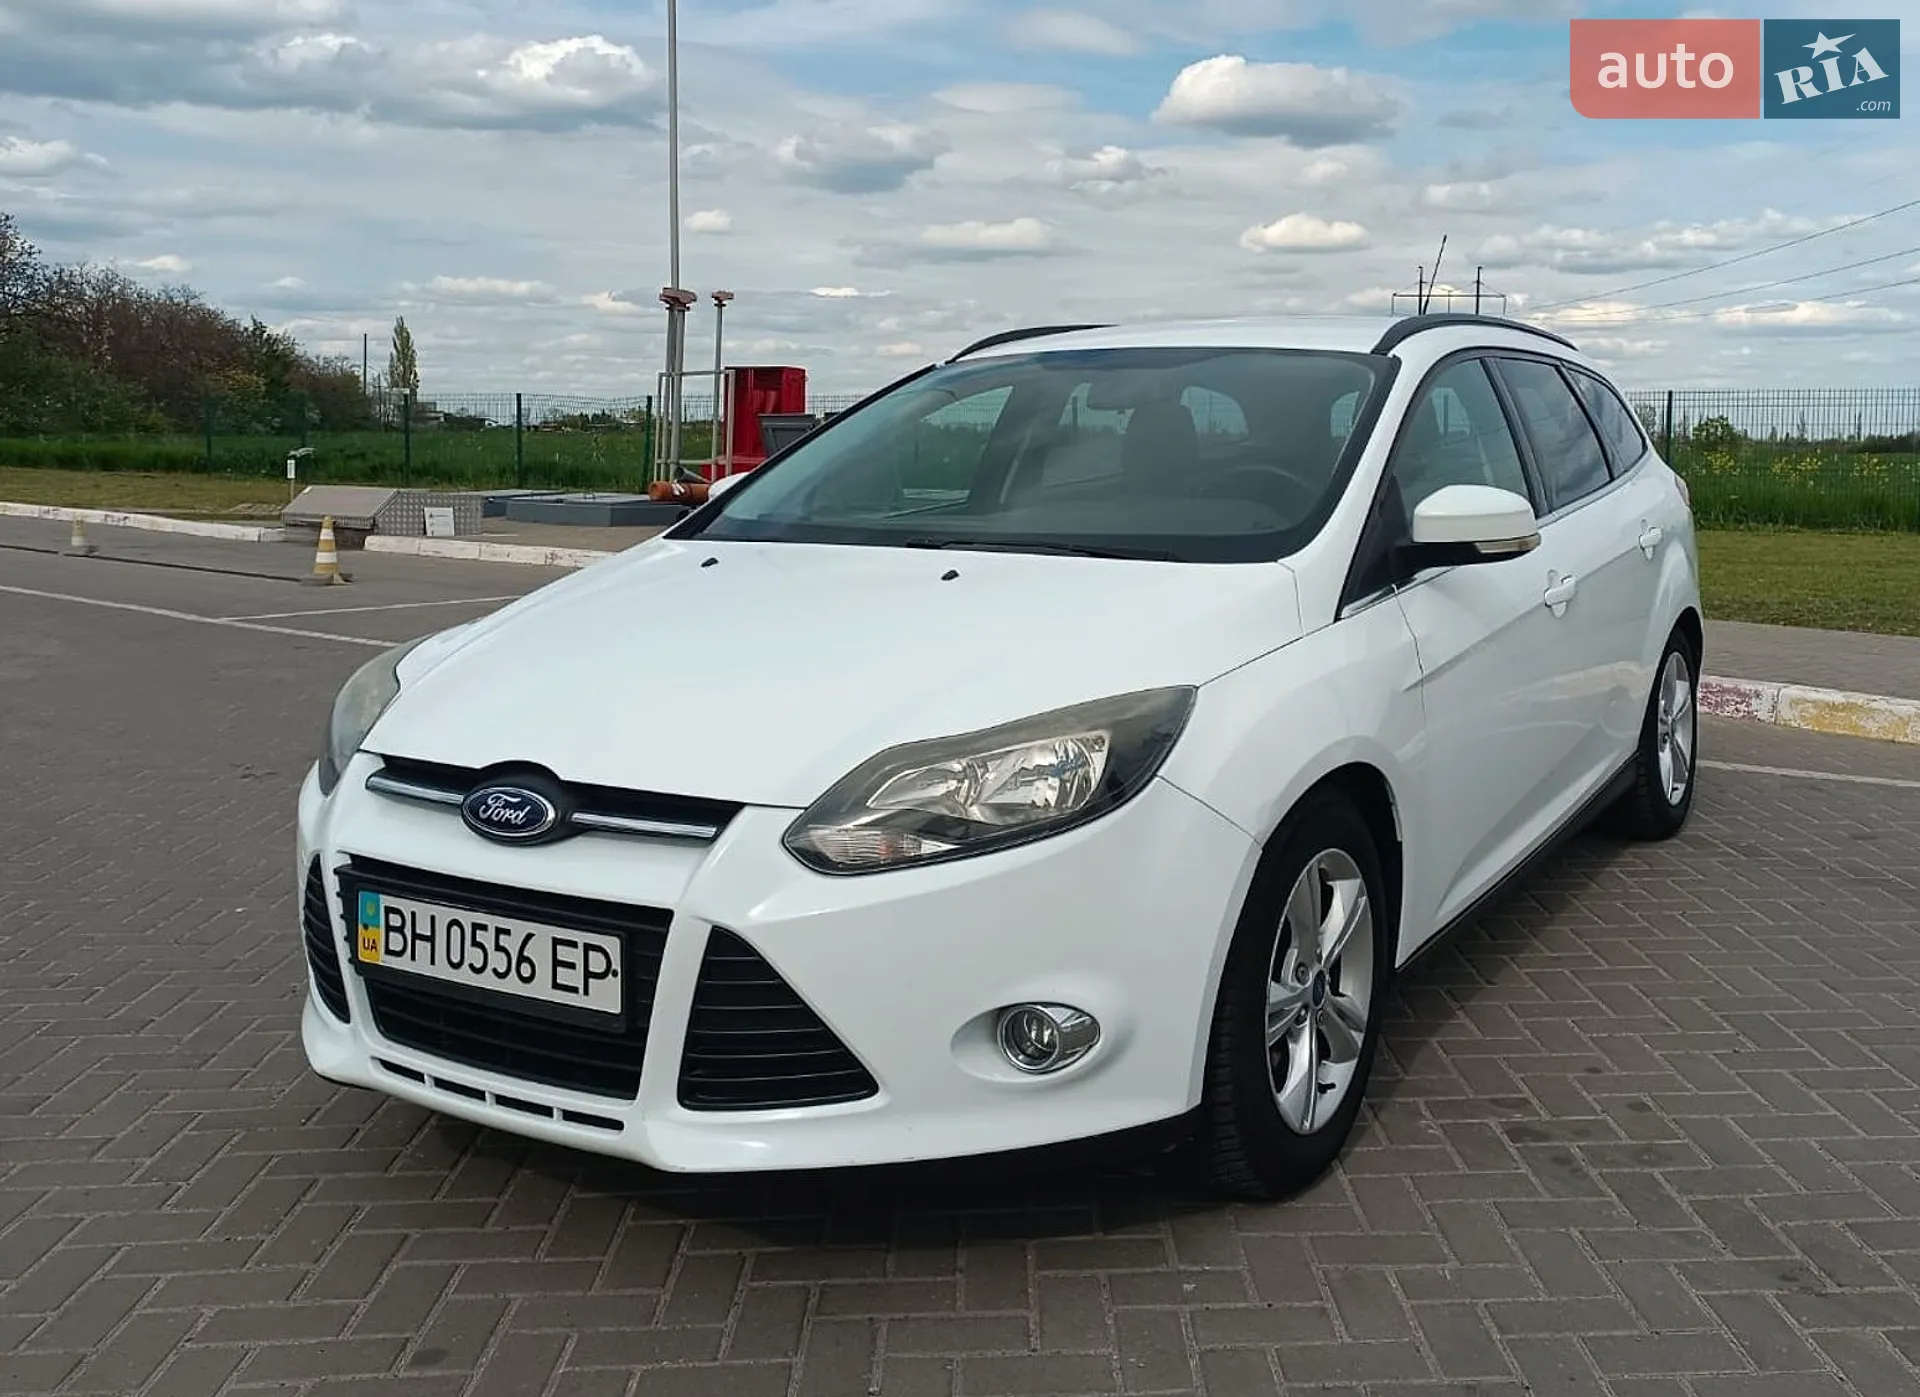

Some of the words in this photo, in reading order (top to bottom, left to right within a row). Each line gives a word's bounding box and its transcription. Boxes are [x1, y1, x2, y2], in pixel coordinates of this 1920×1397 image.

[478, 793, 531, 825] Ford
[363, 937, 378, 954] UA
[383, 905, 436, 966] BH
[446, 918, 537, 984] 0556
[551, 936, 612, 996] EP
